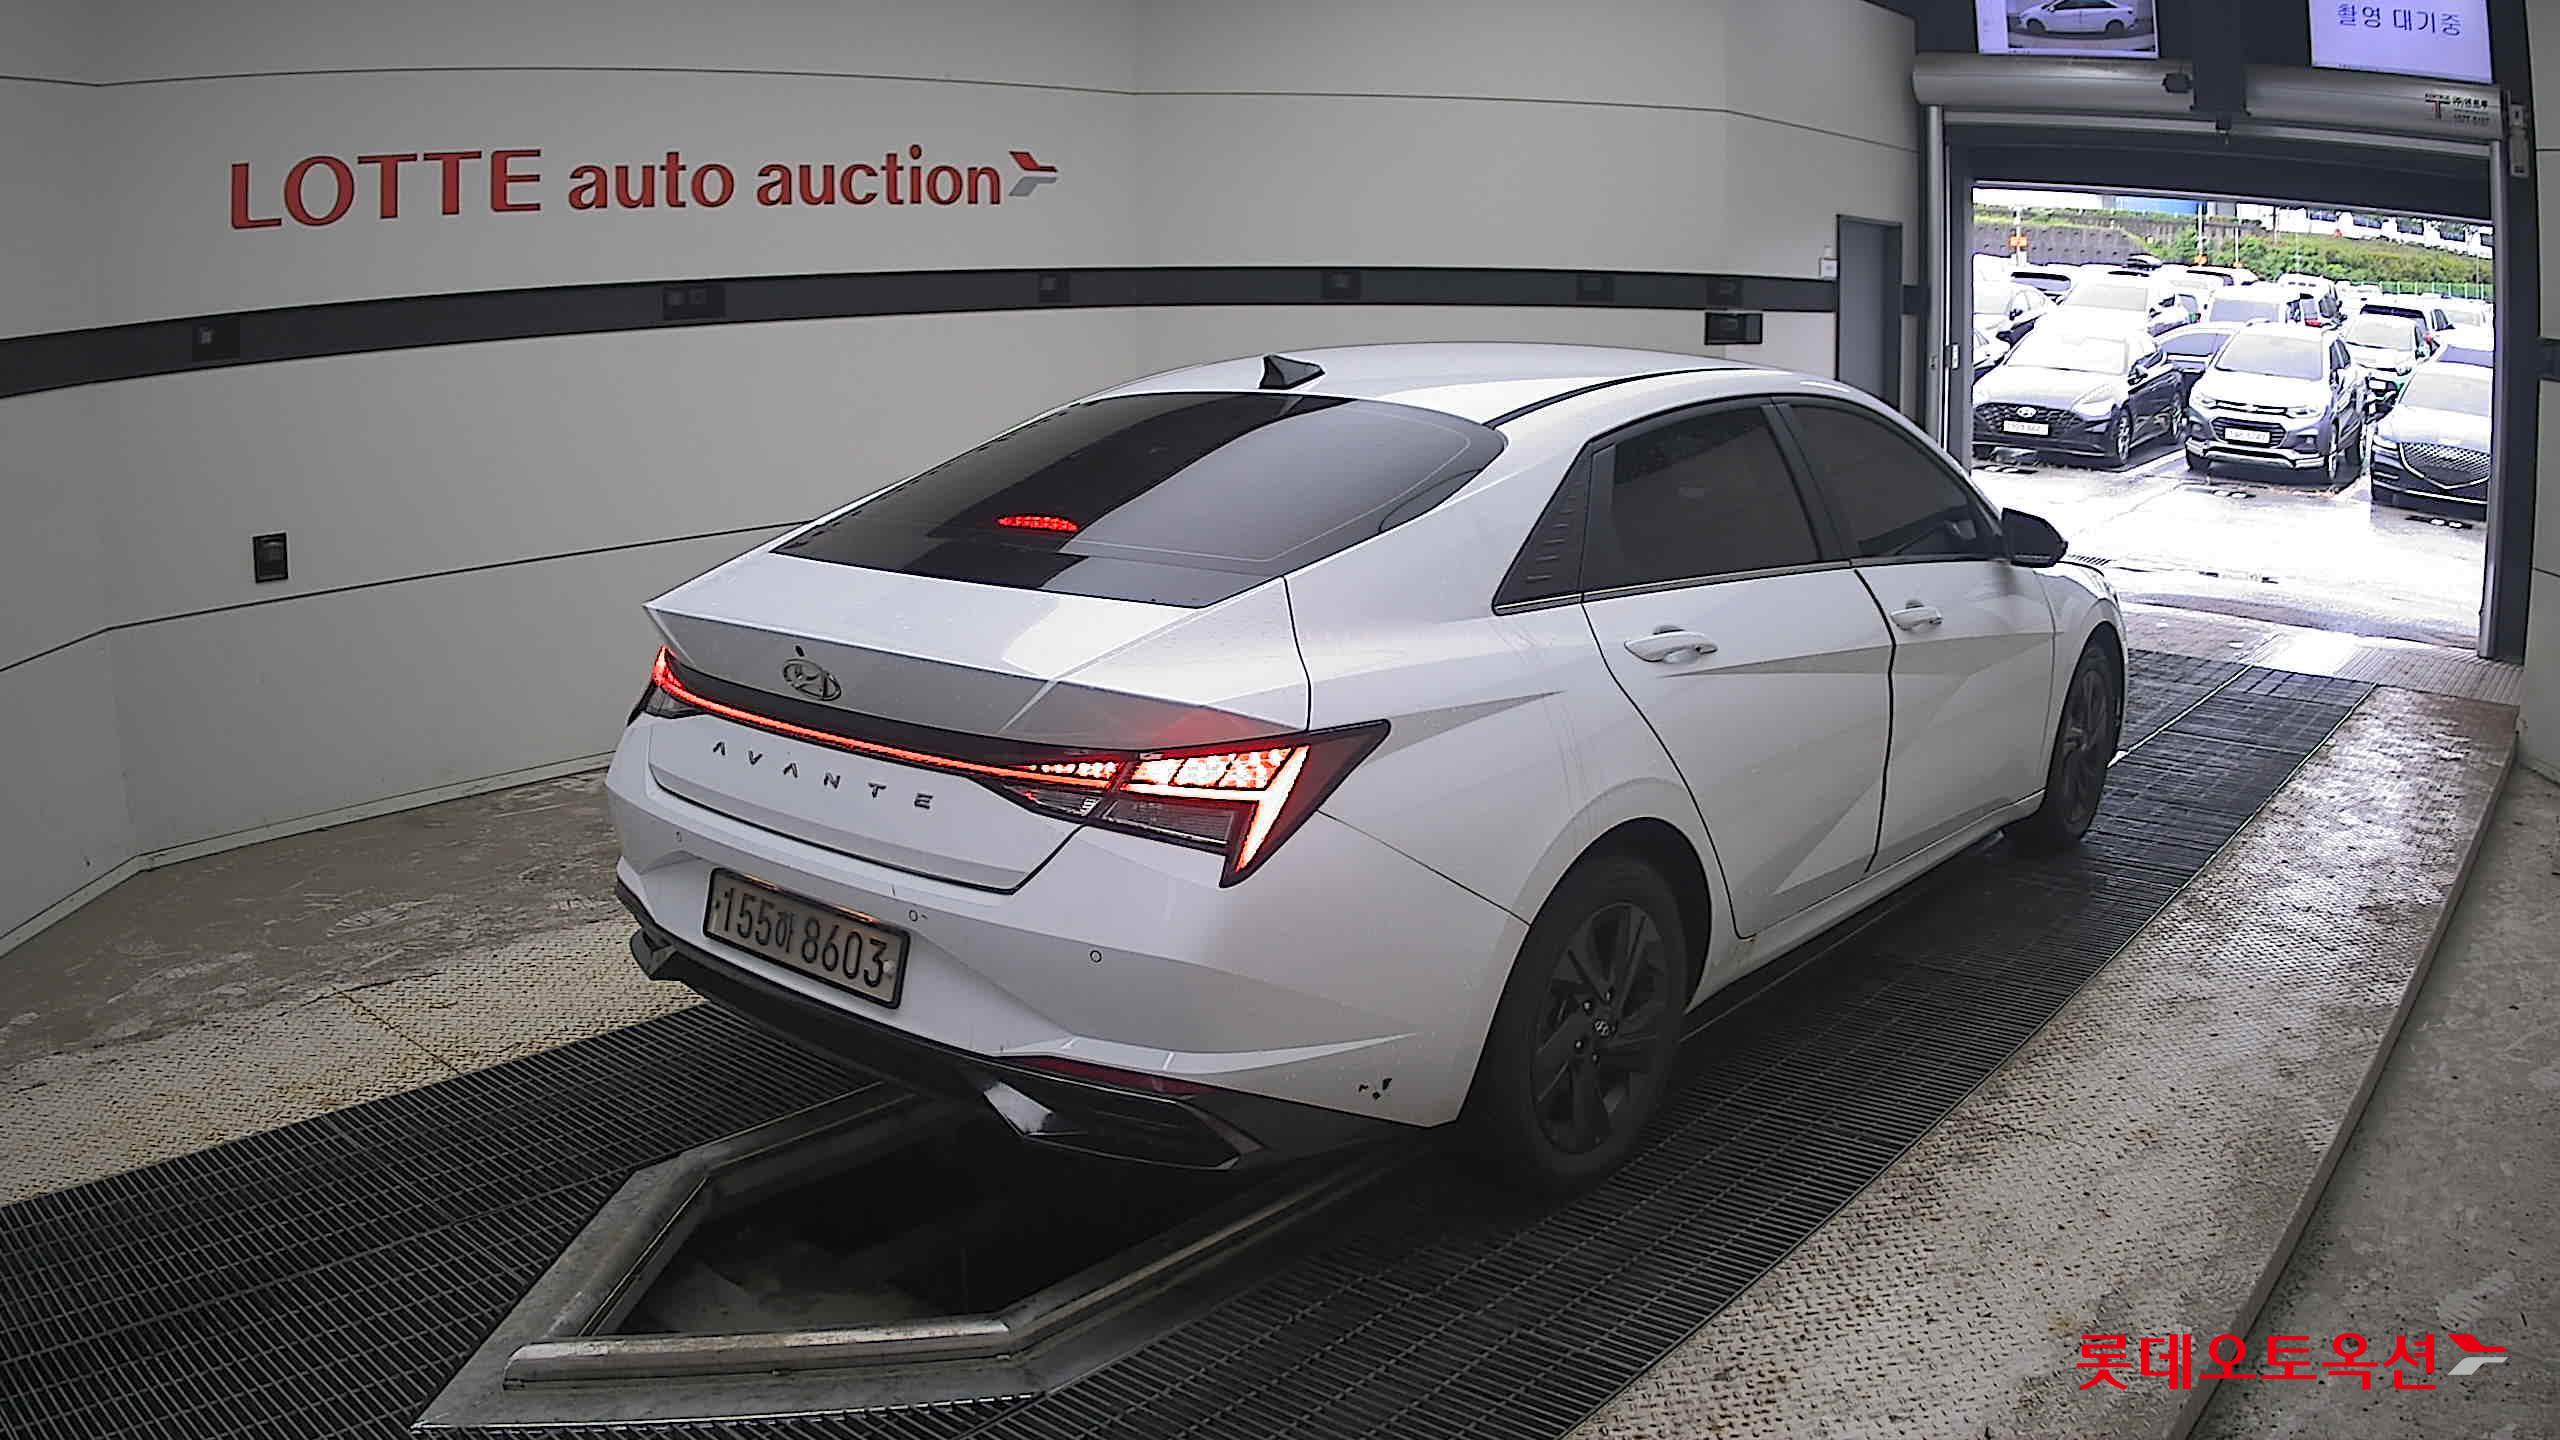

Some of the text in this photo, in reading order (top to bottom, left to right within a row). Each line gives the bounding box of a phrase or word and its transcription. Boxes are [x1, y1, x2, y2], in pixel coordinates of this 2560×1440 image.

[2338, 3, 2461, 36] 촬영 대기중
[230, 145, 1000, 229] LOTTE auto auction
[712, 741, 934, 810] AVANTE
[801, 917, 888, 988] 8603
